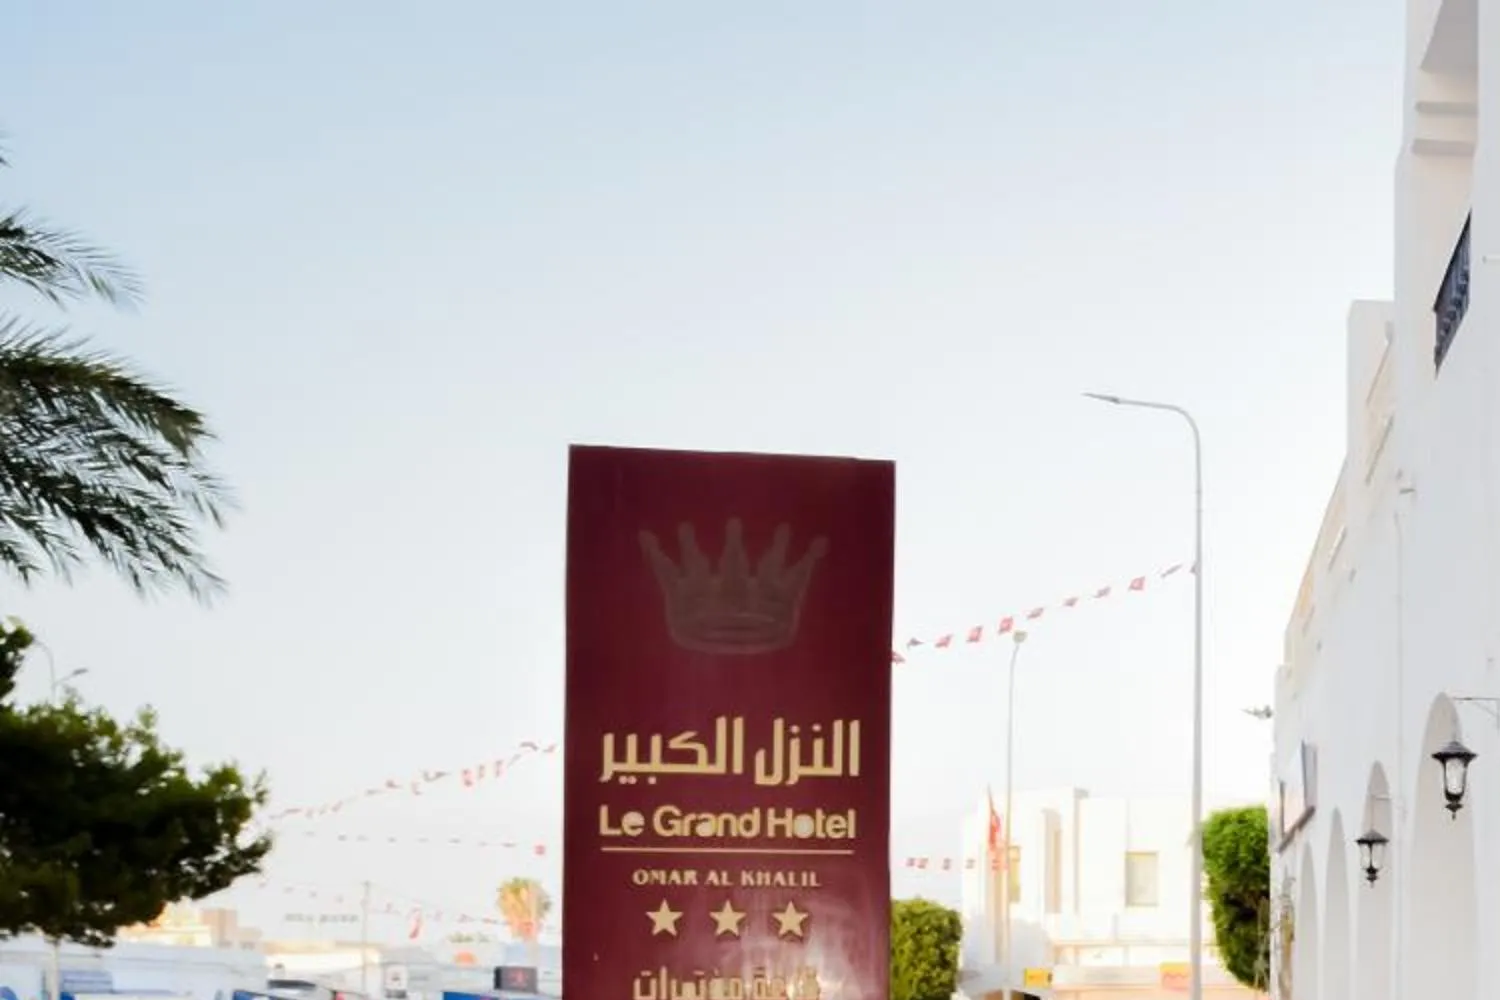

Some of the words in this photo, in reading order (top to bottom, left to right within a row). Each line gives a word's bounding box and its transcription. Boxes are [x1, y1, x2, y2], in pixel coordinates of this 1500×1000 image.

[598, 715, 745, 786] الكبير
[753, 716, 862, 787] النزل
[599, 803, 646, 838] Le
[652, 804, 762, 838] Grand
[766, 806, 857, 840] Hotel
[631, 868, 699, 887] OMAR
[705, 869, 733, 887] AL
[740, 869, 822, 888] KHALIL
